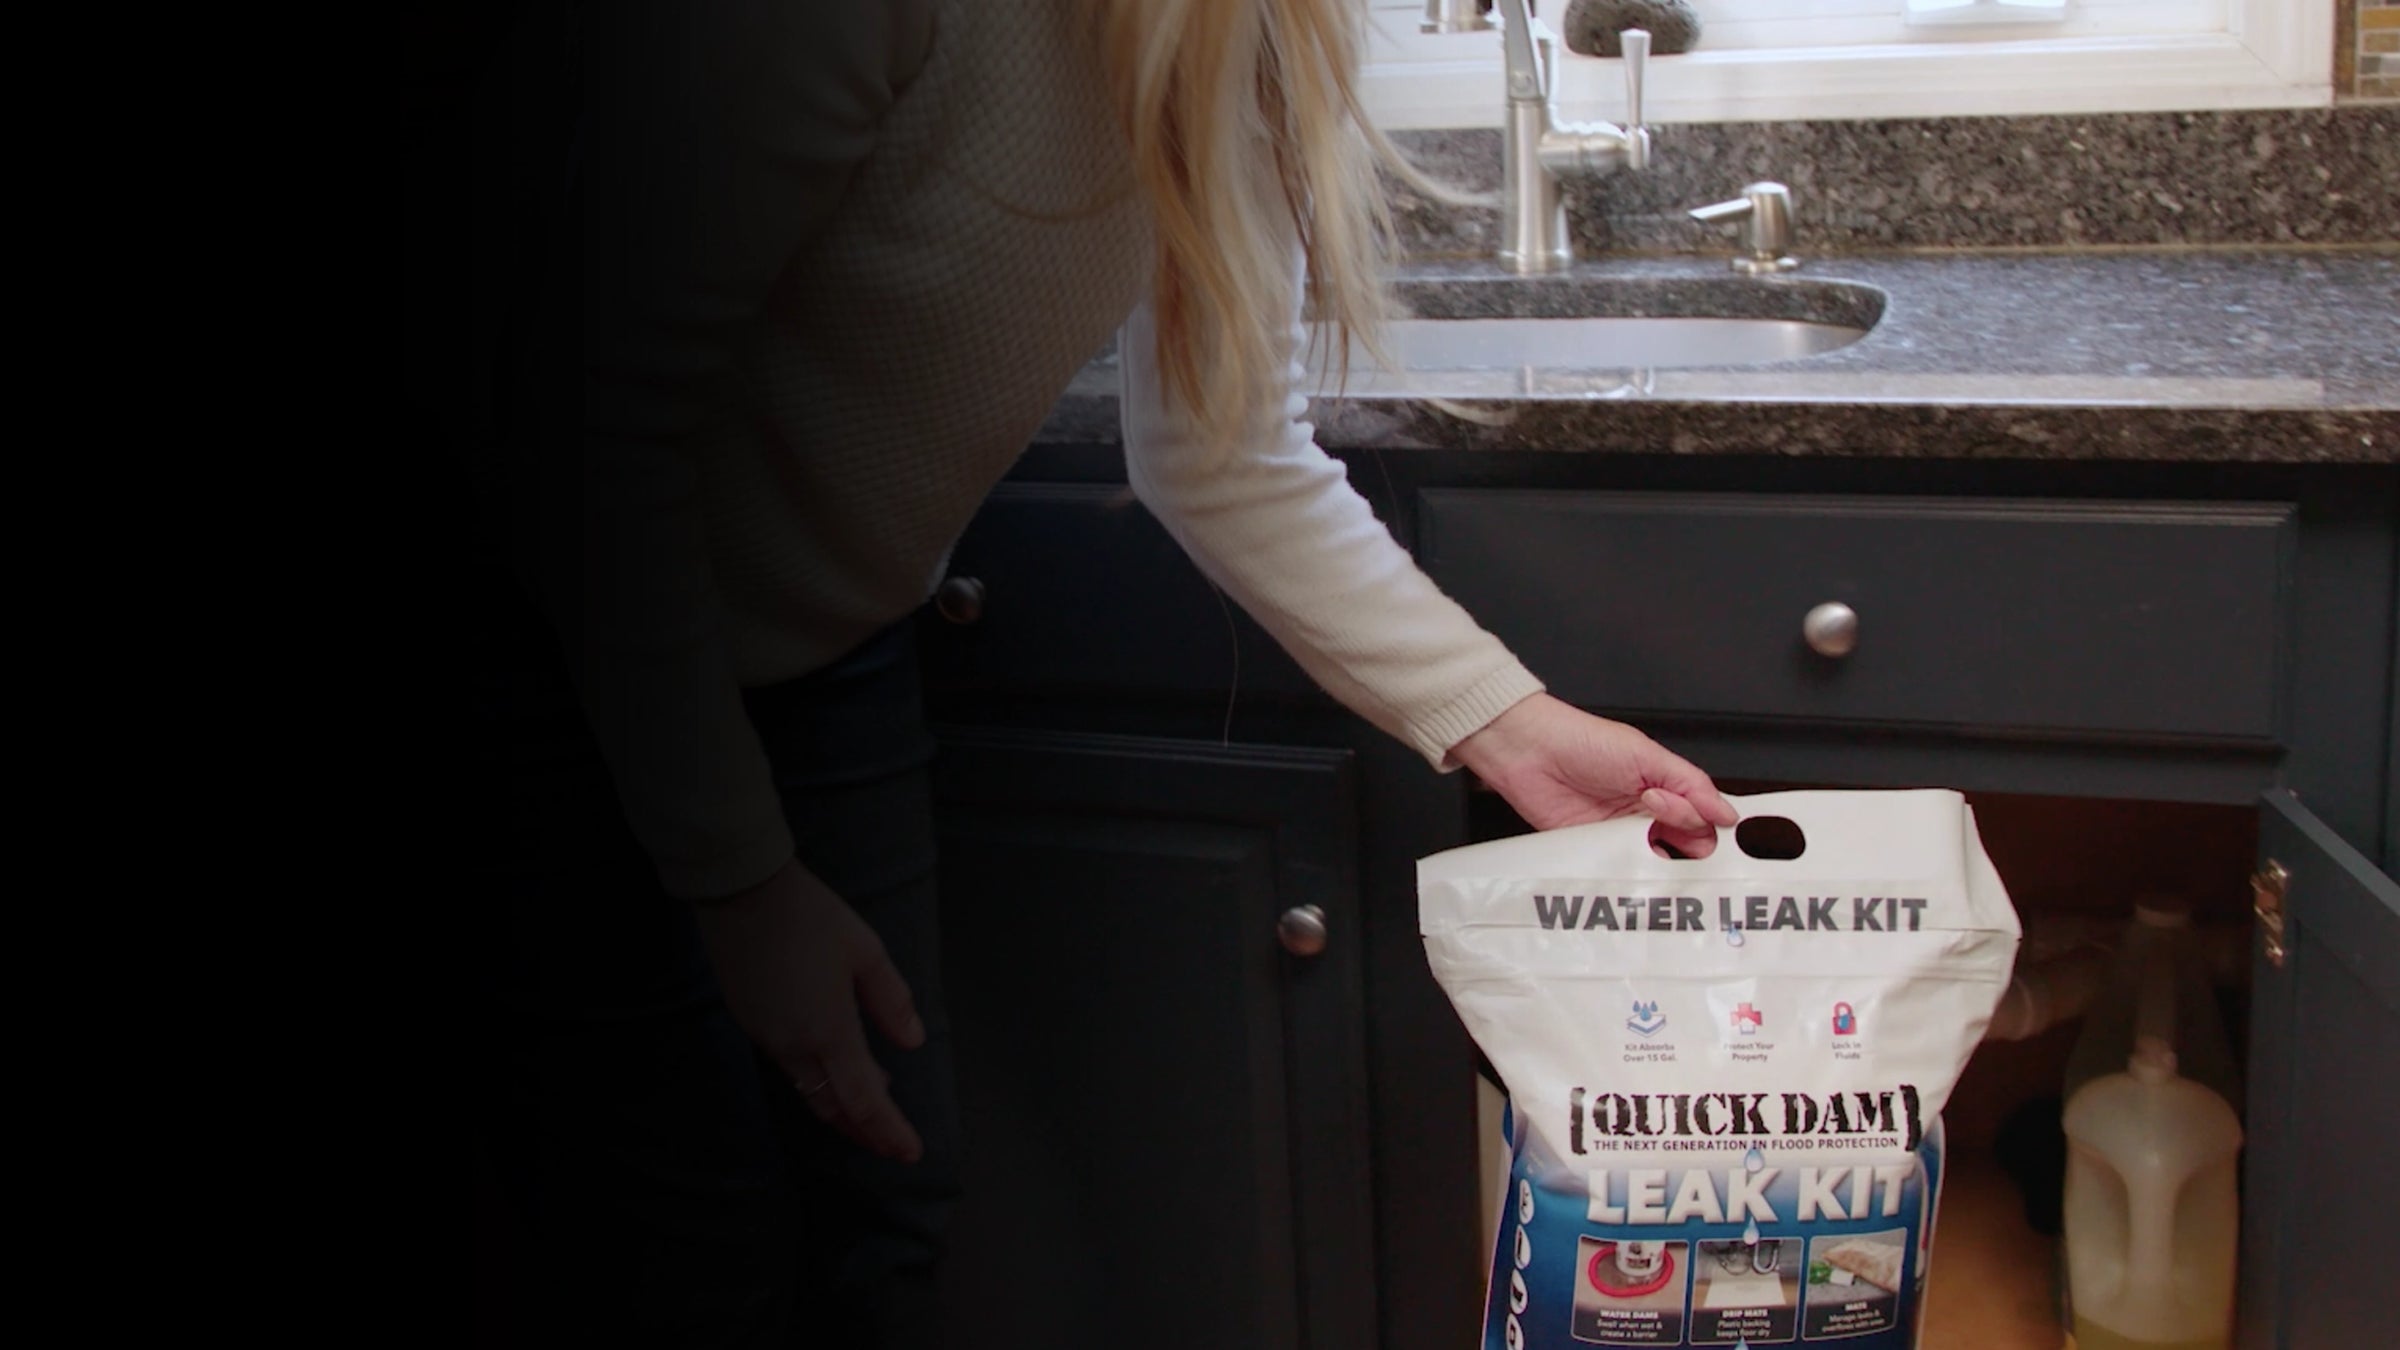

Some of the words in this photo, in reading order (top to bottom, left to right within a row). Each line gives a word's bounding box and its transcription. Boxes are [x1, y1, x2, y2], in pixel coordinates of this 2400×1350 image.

[1533, 895, 1705, 932] WATER
[1718, 896, 1839, 932] LEAK
[1852, 897, 1928, 932] KIT
[1755, 1042, 1775, 1050] Your
[1623, 1054, 1645, 1062] Over
[1732, 1053, 1768, 1062] Property
[1594, 1140, 1619, 1150] THE
[1624, 1140, 1658, 1150] NEXT
[1662, 1140, 1747, 1150] GENERATION
[1752, 1140, 1767, 1149] IN
[1772, 1139, 1814, 1149] FLOOD
[1818, 1137, 1898, 1149] PROTECTION
[1586, 1167, 1782, 1225] LEAK
[1797, 1163, 1916, 1221] KIT
[1600, 1310, 1630, 1319] WATER
[1632, 1311, 1658, 1319] DAMS
[1722, 1310, 1742, 1318] DRIP
[1744, 1309, 1768, 1317] MATS
